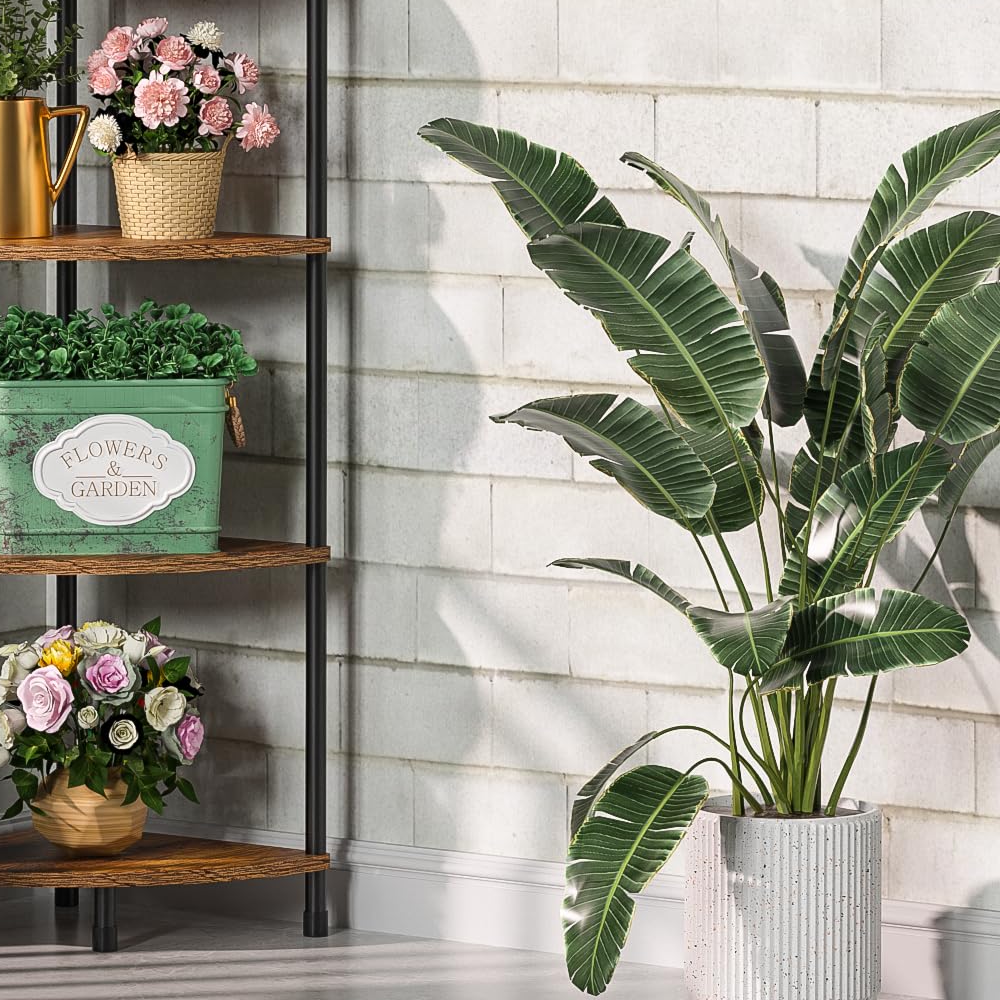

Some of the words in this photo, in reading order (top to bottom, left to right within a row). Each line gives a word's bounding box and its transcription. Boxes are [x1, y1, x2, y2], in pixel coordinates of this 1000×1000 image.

[60, 440, 168, 470] FLOWERS
[107, 461, 122, 477] &
[71, 481, 156, 497] GARDEN
